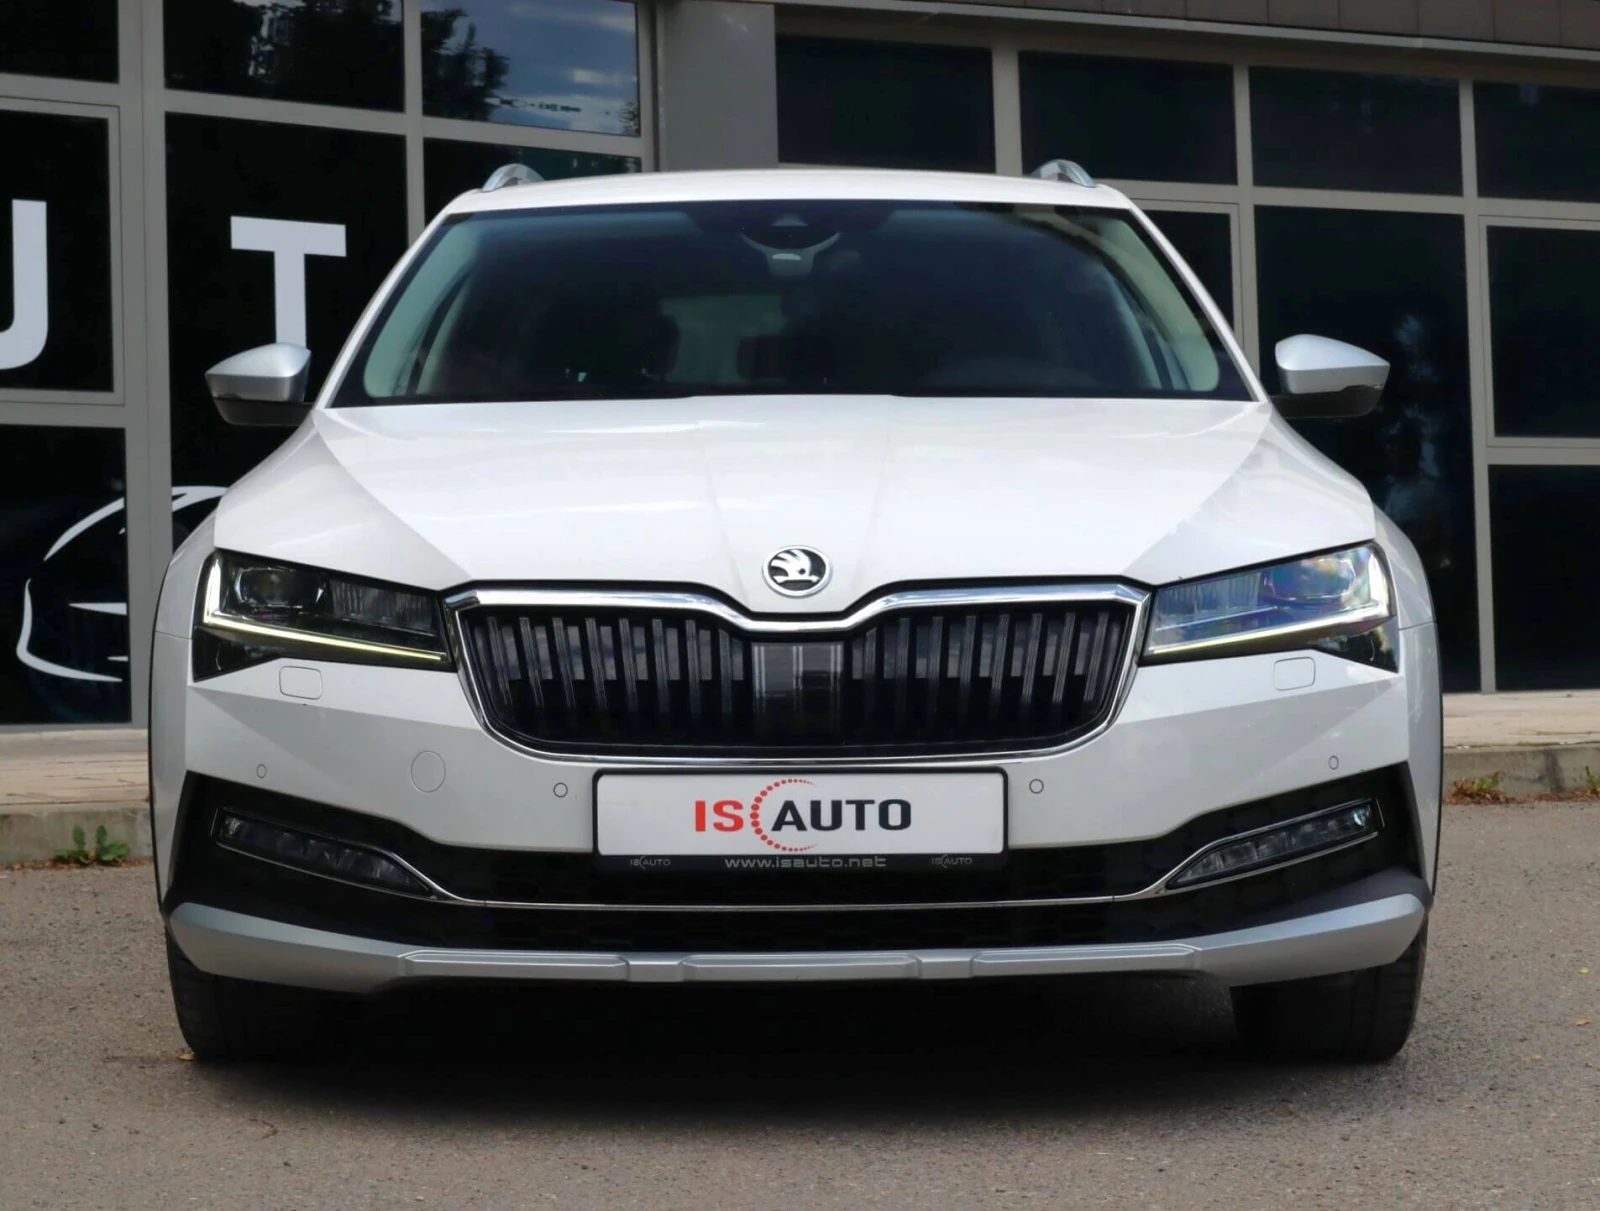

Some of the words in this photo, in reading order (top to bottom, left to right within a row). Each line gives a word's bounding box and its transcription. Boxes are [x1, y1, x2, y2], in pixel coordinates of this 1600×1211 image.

[695, 799, 744, 833] IS
[771, 798, 912, 832] AUTO
[725, 856, 887, 868] www.isauto.net
